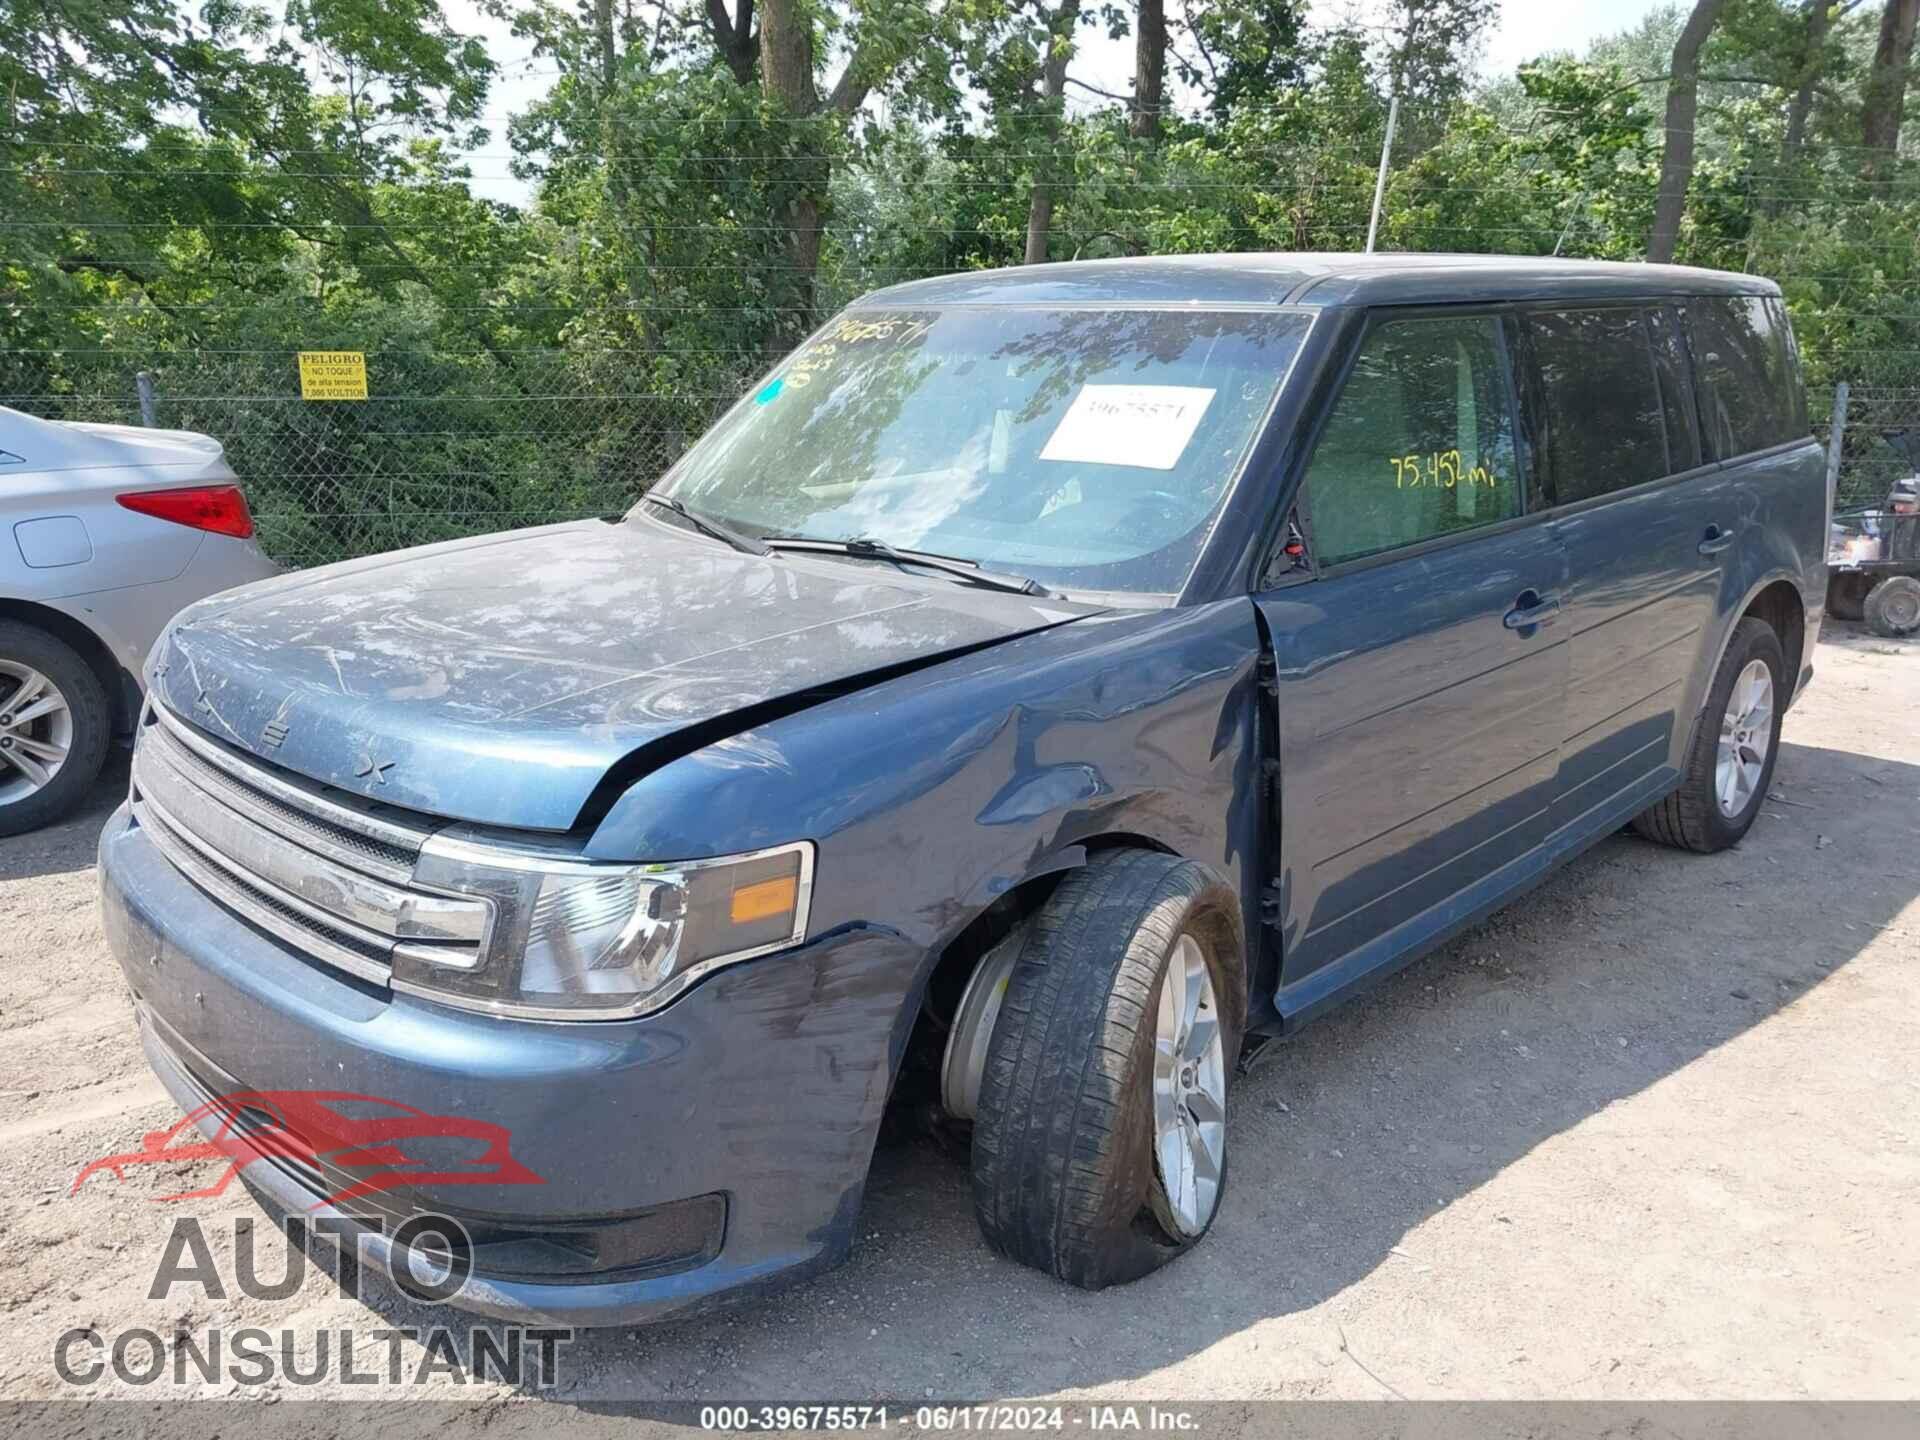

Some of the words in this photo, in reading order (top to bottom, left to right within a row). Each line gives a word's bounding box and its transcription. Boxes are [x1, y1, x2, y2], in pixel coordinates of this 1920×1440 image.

[302, 354, 362, 364] PELIGRO
[312, 367, 324, 375] NO
[326, 367, 352, 375] TOQUE
[327, 388, 365, 398] VOLTIOS
